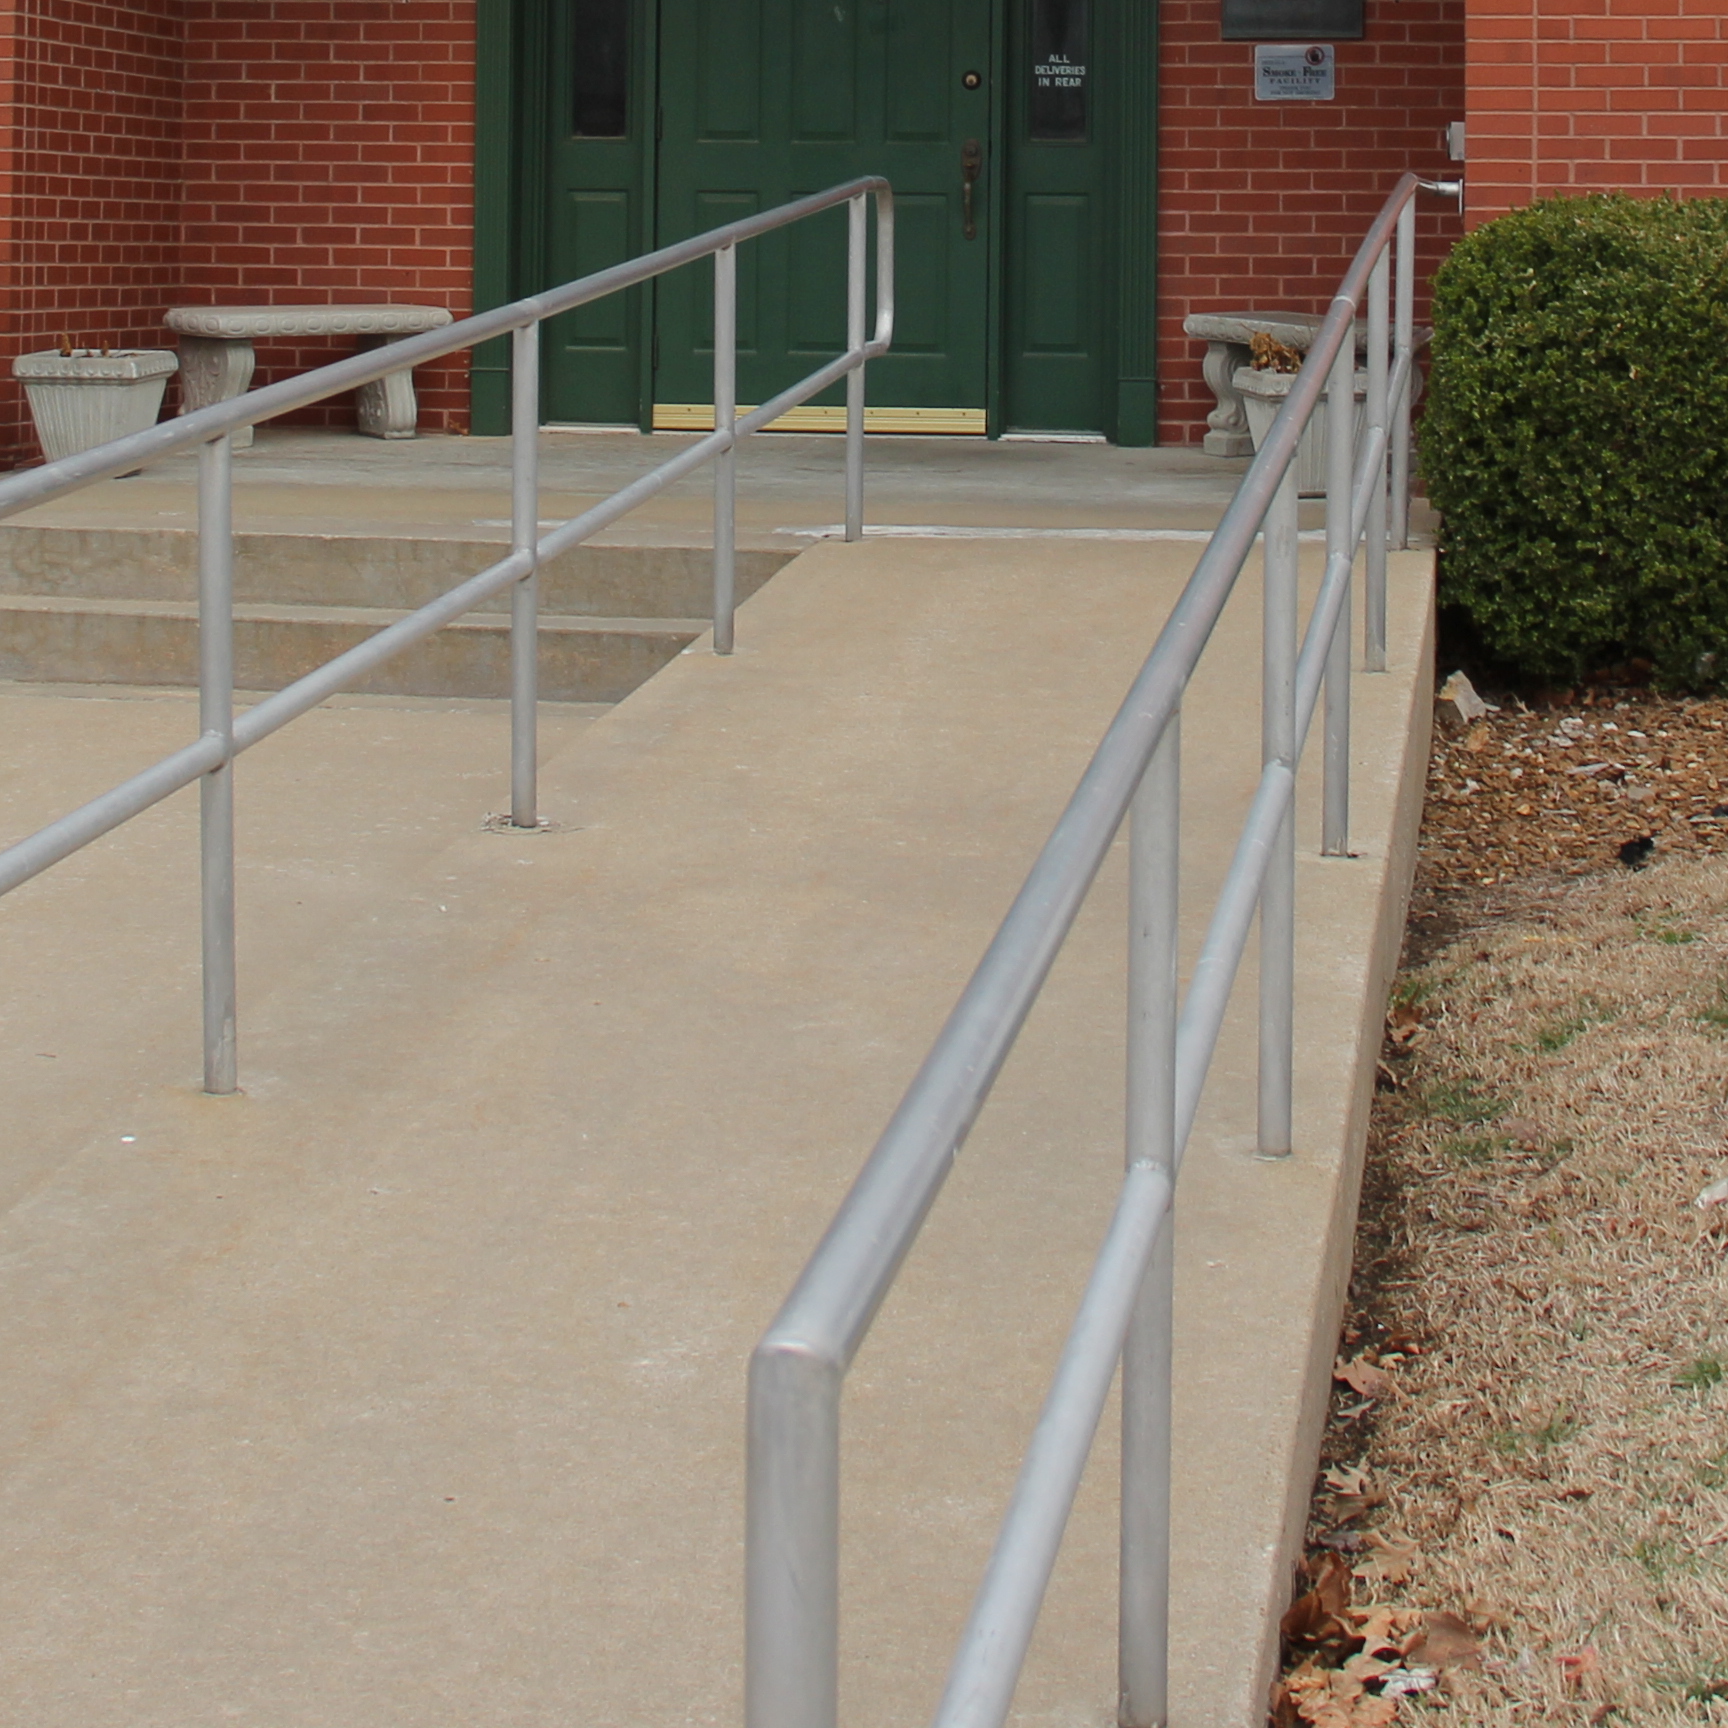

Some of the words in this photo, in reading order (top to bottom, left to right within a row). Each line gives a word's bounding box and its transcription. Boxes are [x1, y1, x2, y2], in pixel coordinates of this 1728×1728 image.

[1048, 54, 1070, 63] ALL
[1035, 65, 1086, 75] DELIVERIES
[1038, 77, 1050, 87] IN
[1055, 77, 1082, 87] REAR
